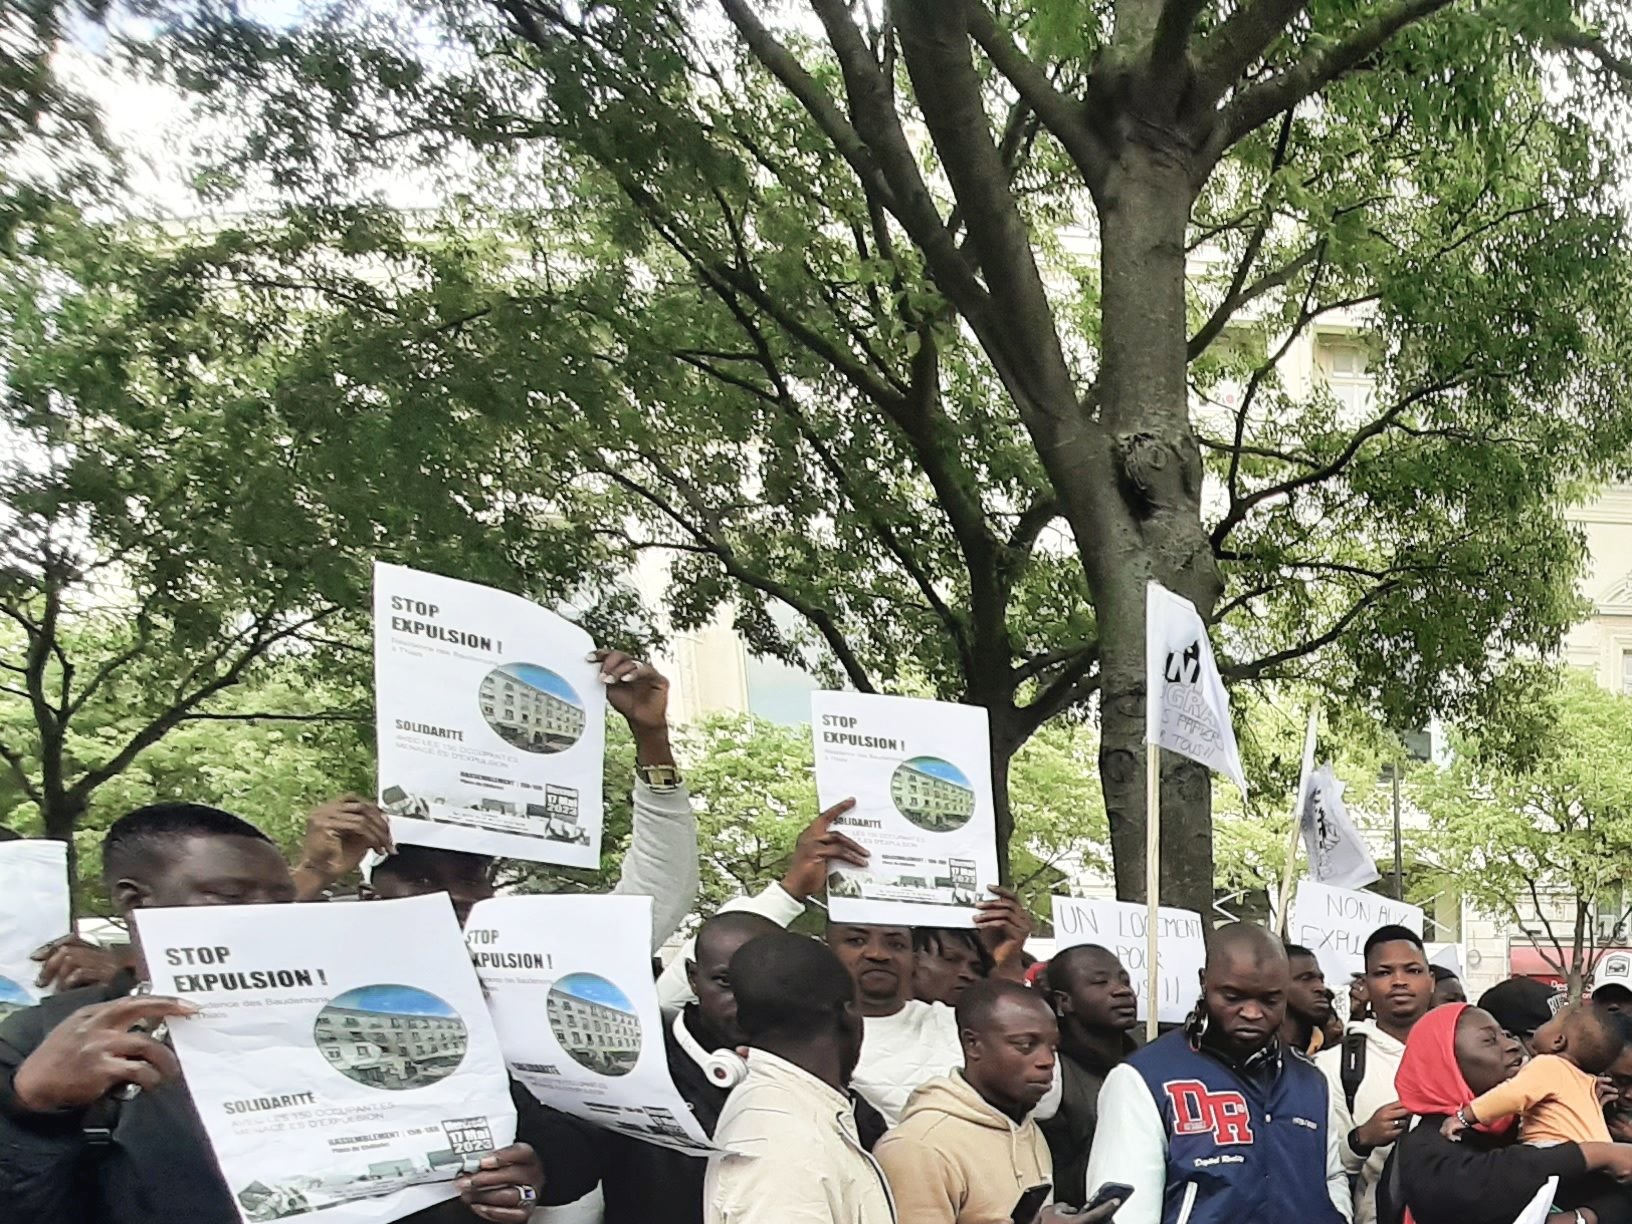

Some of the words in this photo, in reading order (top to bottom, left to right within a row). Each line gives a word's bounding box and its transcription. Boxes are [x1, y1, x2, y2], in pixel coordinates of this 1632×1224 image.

[391, 595, 440, 618] STOP
[391, 616, 492, 651] EXPULSION
[822, 714, 858, 729] STOP
[823, 731, 897, 751] EXPULSION
[1060, 904, 1100, 935] UN
[1326, 893, 1371, 923] NON
[464, 929, 499, 945] STOP
[166, 946, 230, 965] STOP
[173, 969, 313, 993] EXPULSION
[317, 968, 328, 986] !
[1163, 1079, 1254, 1146] DR
[452, 1139, 493, 1154] 2023
